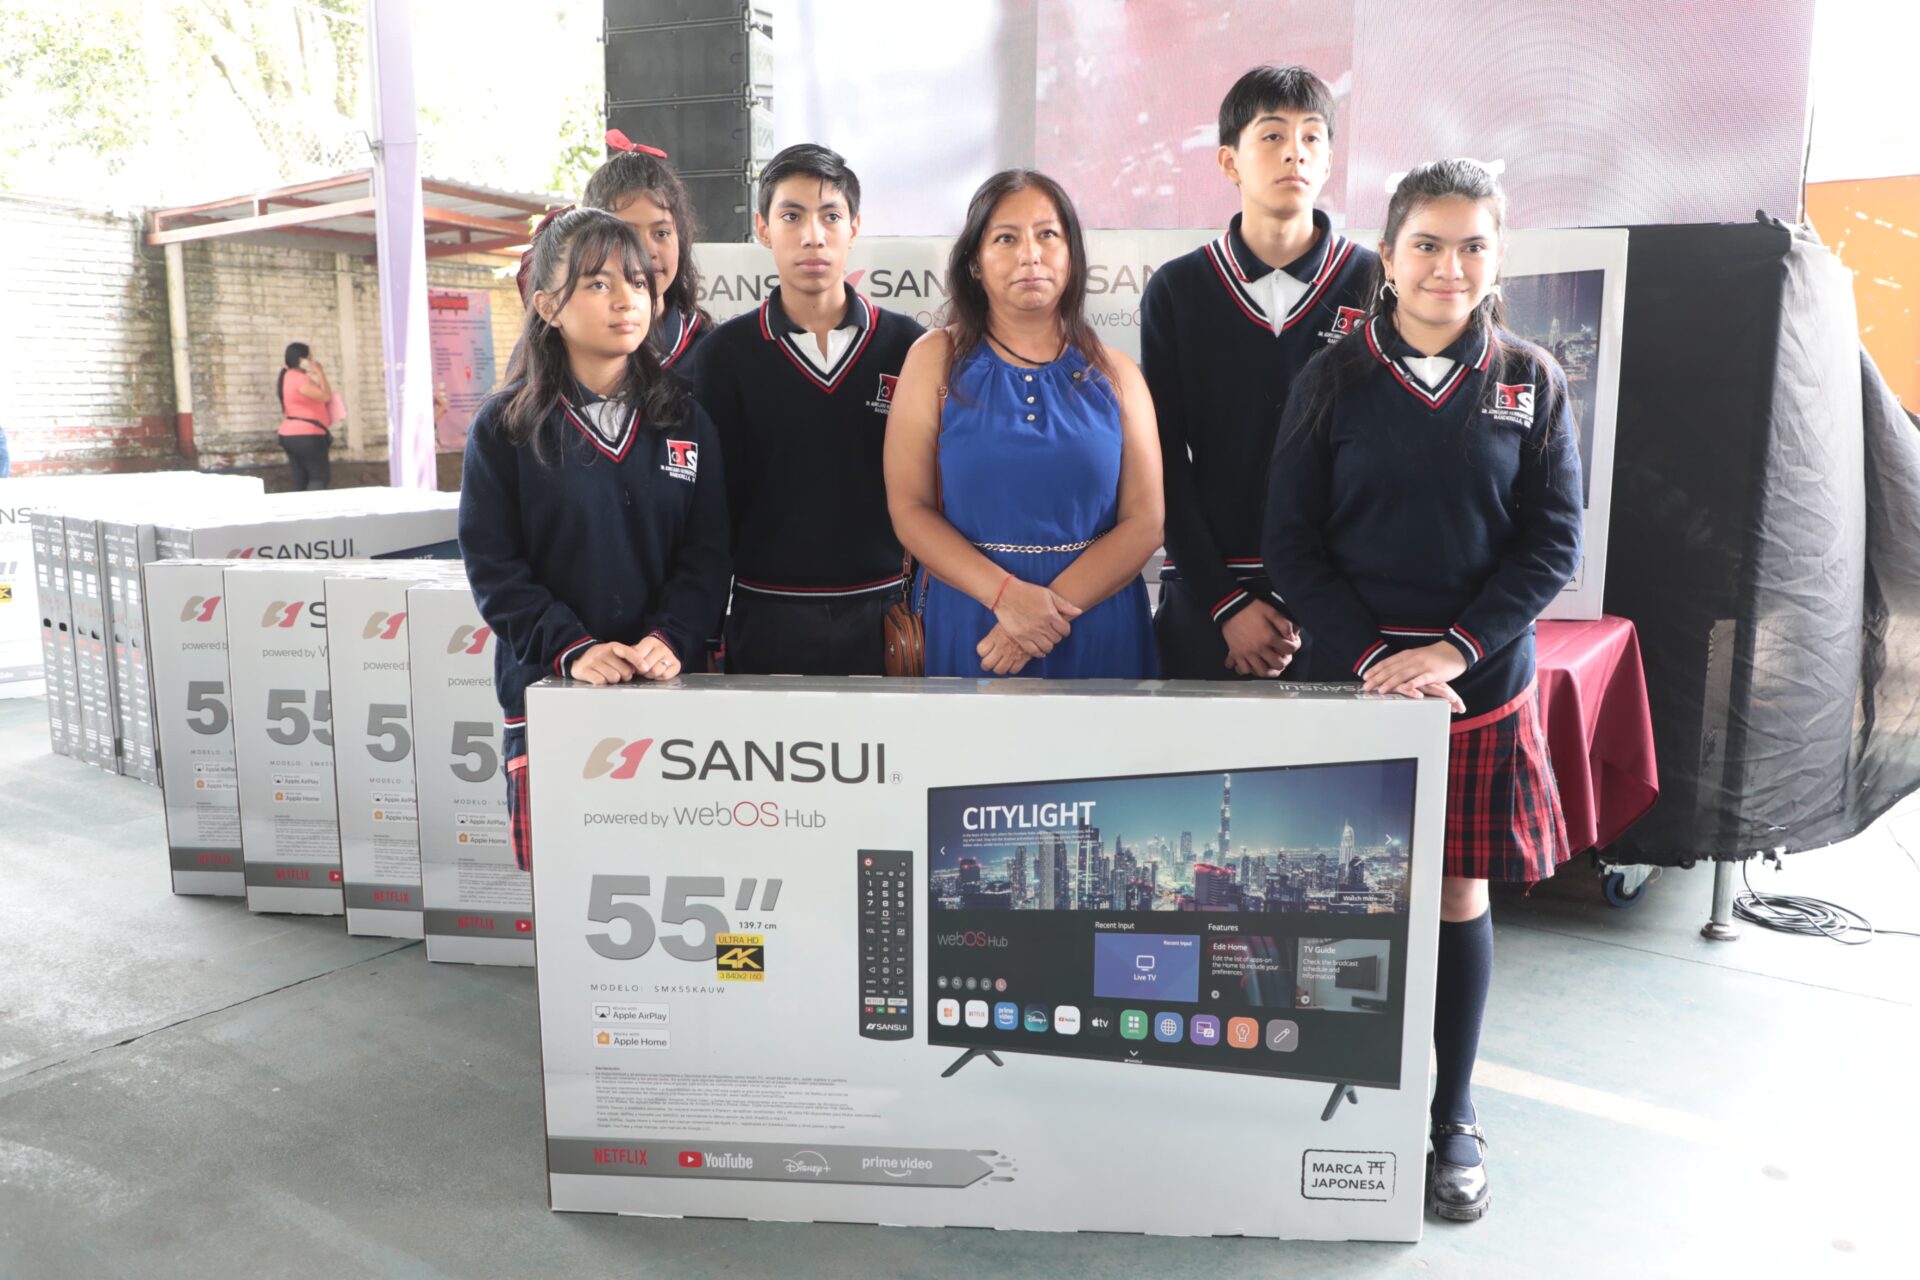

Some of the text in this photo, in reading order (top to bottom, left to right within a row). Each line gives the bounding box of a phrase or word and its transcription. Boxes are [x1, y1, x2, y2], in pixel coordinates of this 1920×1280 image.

[257, 538, 354, 560] SANSUI
[182, 641, 221, 651] powered
[262, 648, 303, 658] powered
[305, 648, 317, 660] by
[363, 661, 405, 671] powered
[448, 677, 492, 687] powered
[660, 738, 886, 784] SANSUI
[584, 800, 826, 829] powered by webOS Hub
[963, 801, 1097, 830] CITYLIGHT
[739, 921, 762, 930] 139.7
[1095, 921, 1135, 931] Recent Input
[1208, 923, 1239, 932] Features
[718, 936, 745, 944] ULTRA
[937, 930, 1009, 947] webOS Hub
[1227, 943, 1248, 951] Home
[1304, 945, 1336, 954] TV Guide
[718, 947, 763, 969] 4K
[1328, 966, 1340, 974] and
[1133, 973, 1147, 981] Live
[613, 1011, 667, 1022] Apple AirPlay
[876, 1023, 908, 1031] SANSUI
[613, 1037, 667, 1047] Apple Home
[594, 1148, 648, 1166] NETFLIX
[704, 1152, 754, 1169] YouTube
[861, 1156, 934, 1170] prime video
[1312, 1163, 1363, 1175] MARCA
[1311, 1178, 1386, 1190] JAPONESA
